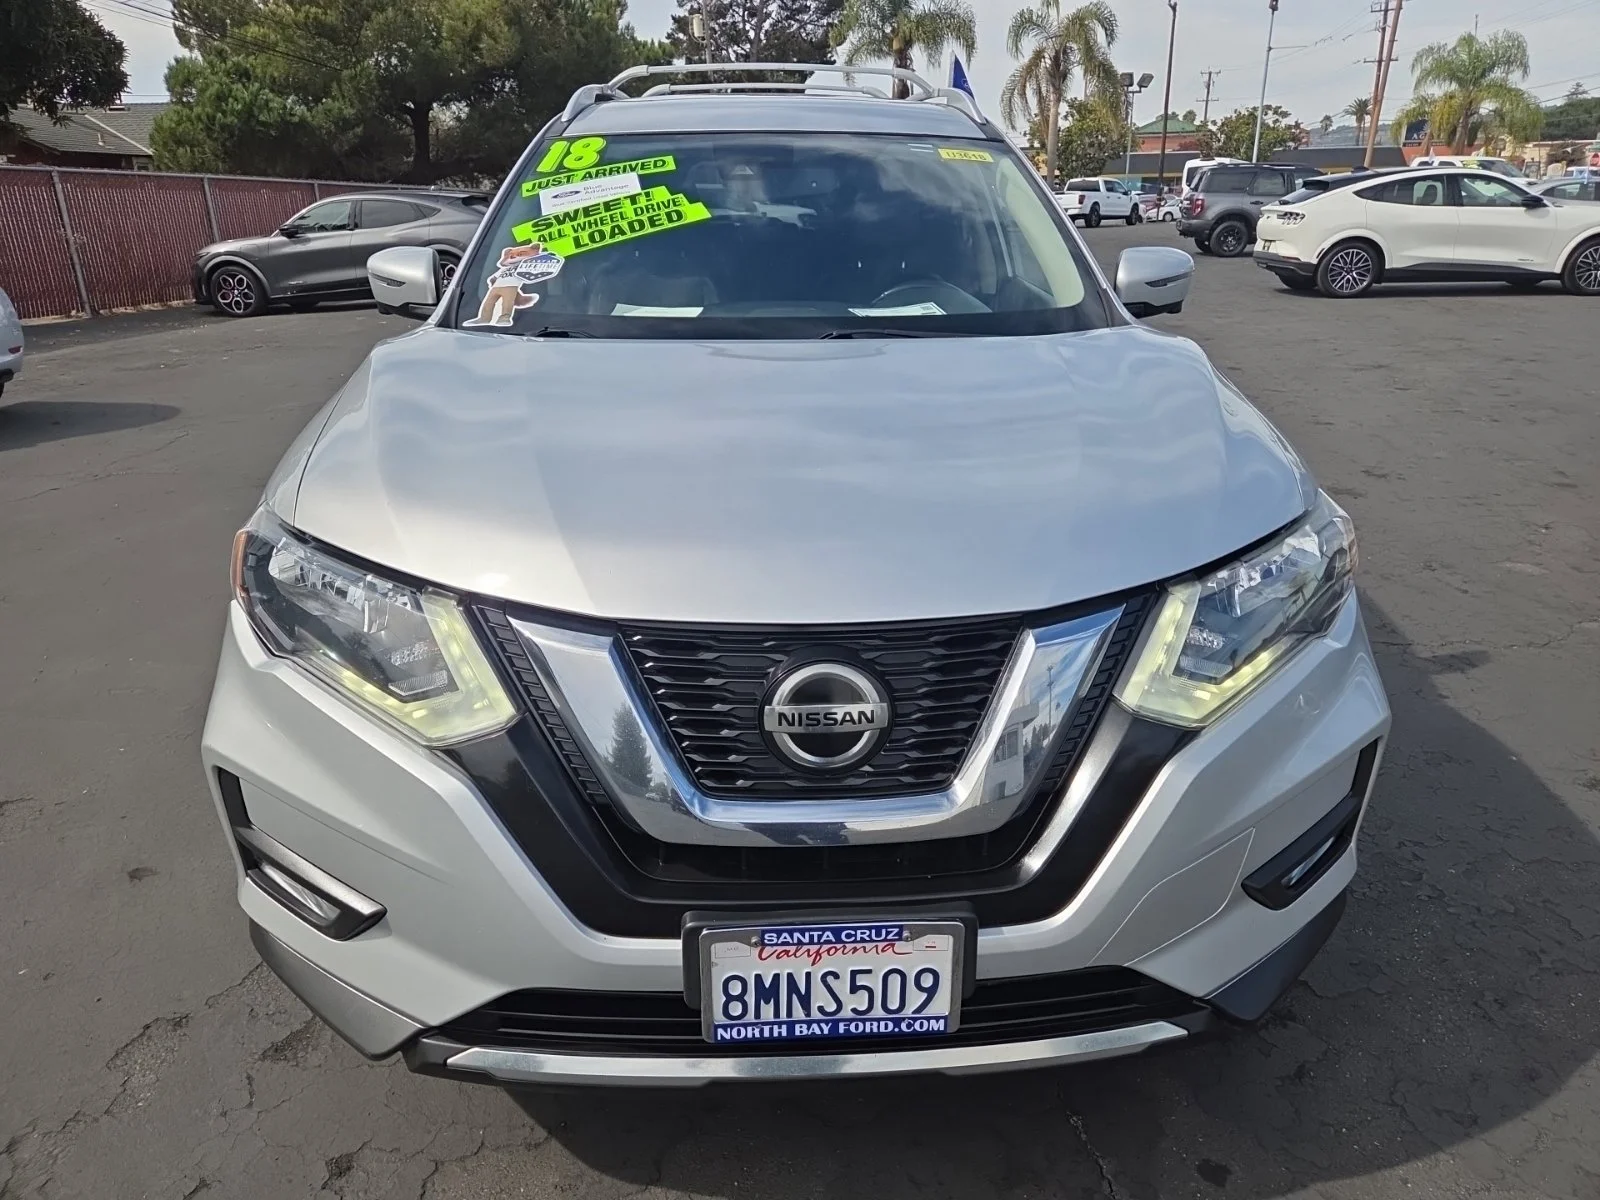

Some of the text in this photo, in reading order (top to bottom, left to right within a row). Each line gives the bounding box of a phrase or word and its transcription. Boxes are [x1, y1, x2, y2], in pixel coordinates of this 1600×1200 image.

[536, 136, 607, 173] 18
[526, 159, 669, 193] JUST ARRIVED
[585, 184, 630, 195] Advantage
[531, 190, 654, 234] SWEET!
[537, 196, 685, 244] ALL WHEEL DRIVE
[572, 209, 688, 250] LOADED
[777, 709, 875, 727] NISSAN
[763, 928, 901, 945] SANTA CRUZ
[758, 941, 913, 967] California
[721, 967, 941, 1021] 8MNS509
[717, 1018, 946, 1040] NORTH BAY FORD.COM
